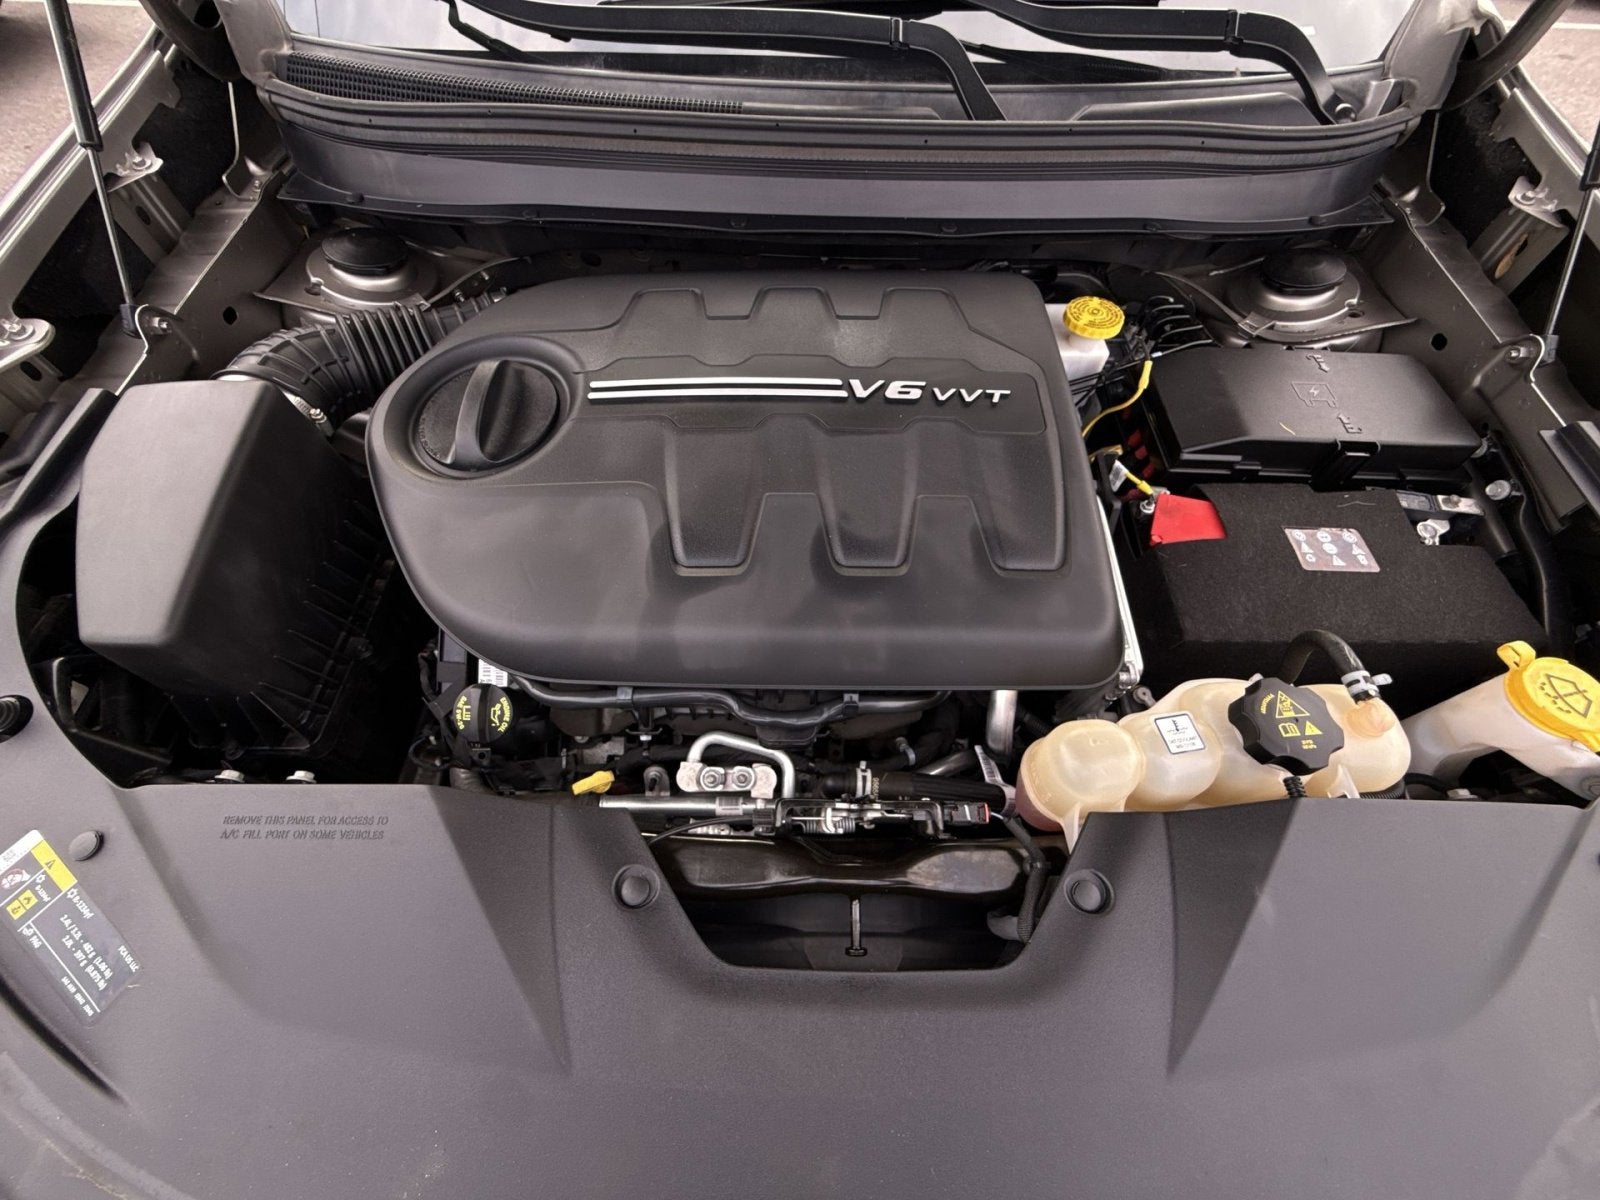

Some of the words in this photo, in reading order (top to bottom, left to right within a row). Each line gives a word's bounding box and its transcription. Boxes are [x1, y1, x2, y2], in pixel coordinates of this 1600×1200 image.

[849, 379, 926, 399] V6
[932, 387, 1011, 403] VVT
[457, 695, 467, 708] SAE
[500, 696, 510, 722] ENGINE
[497, 722, 508, 733] OIL
[222, 815, 263, 825] REMOVE
[264, 815, 285, 825] THIS
[286, 815, 316, 825] PANEL
[317, 815, 337, 825] FOR
[338, 815, 375, 825] ACCESS
[377, 815, 389, 825] TO
[219, 829, 239, 840] A/C
[242, 829, 262, 839] FILL
[265, 829, 291, 839] PORT
[292, 829, 308, 839] ON
[308, 829, 336, 839] SOME
[339, 829, 385, 839] VEHICLES
[117, 945, 128, 957] FCA
